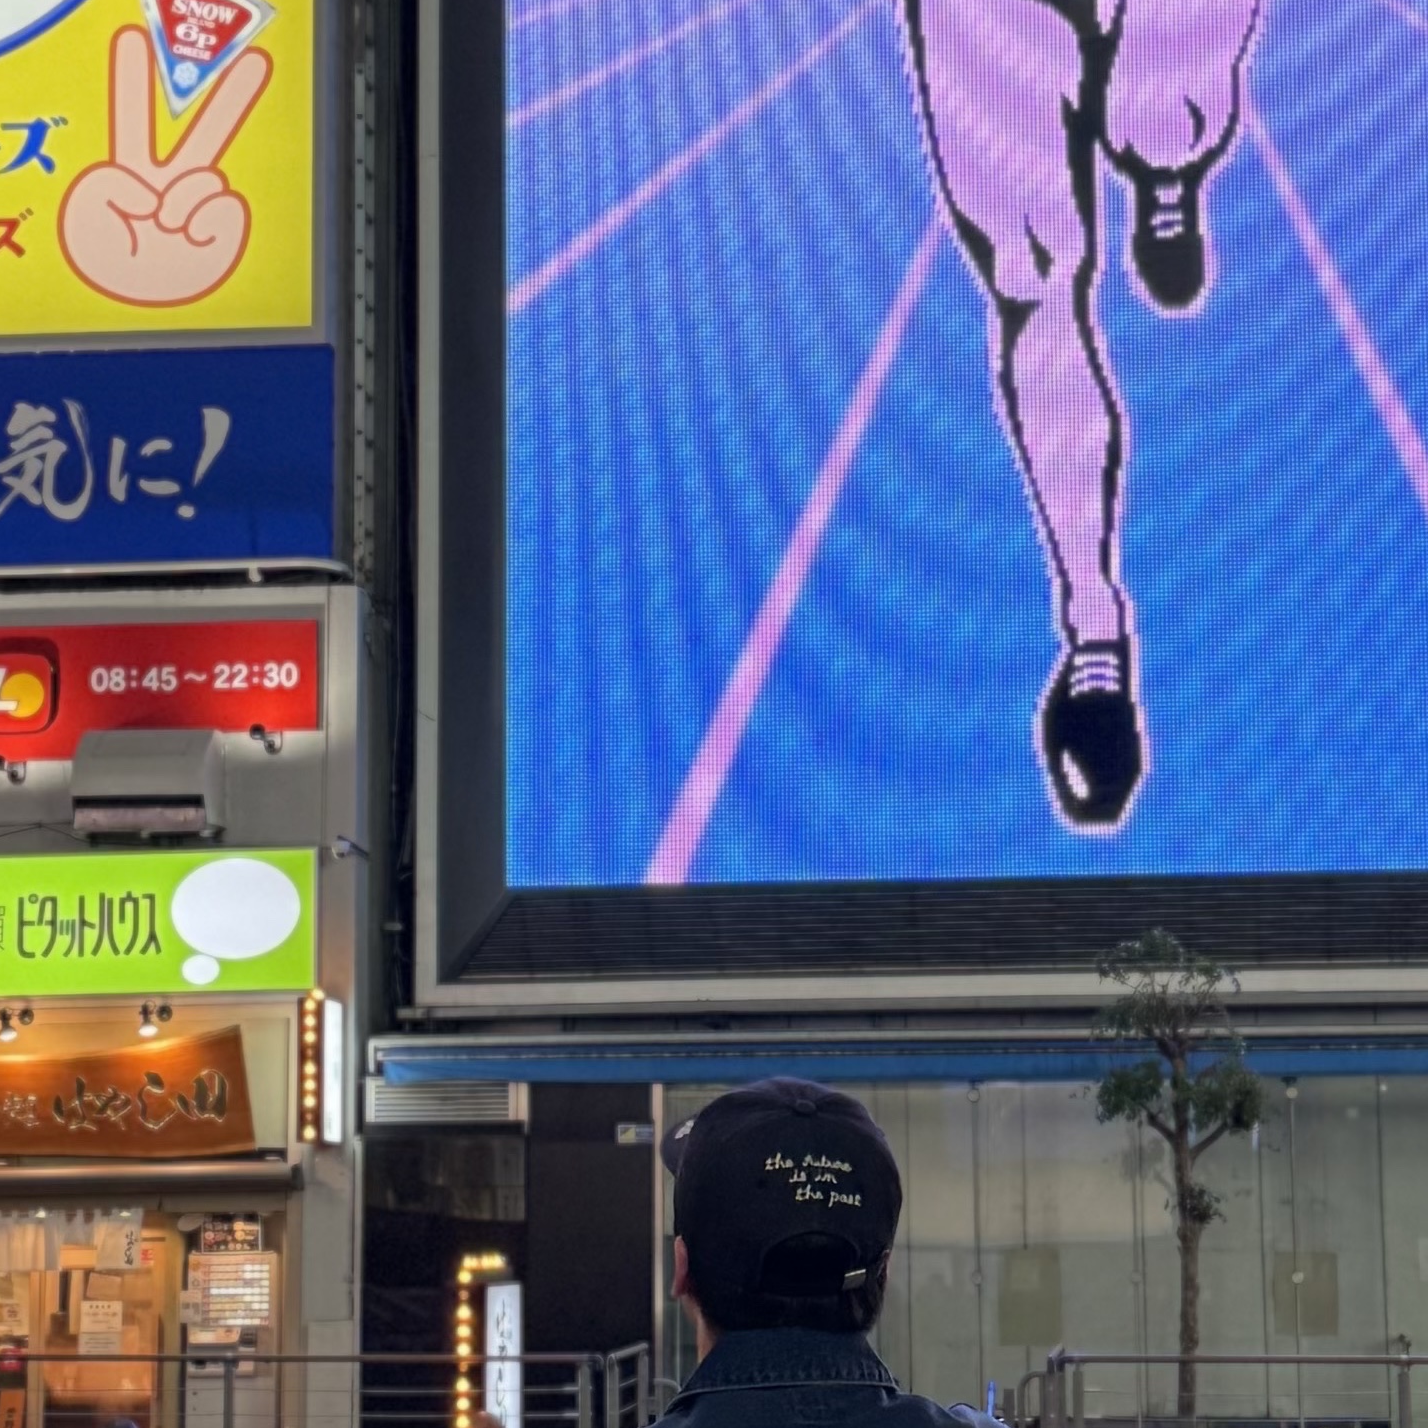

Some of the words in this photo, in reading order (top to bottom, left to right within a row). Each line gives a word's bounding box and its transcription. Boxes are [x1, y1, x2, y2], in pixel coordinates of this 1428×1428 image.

[16, 892, 162, 960] ピタットハウス
[765, 1152, 794, 1170] the
